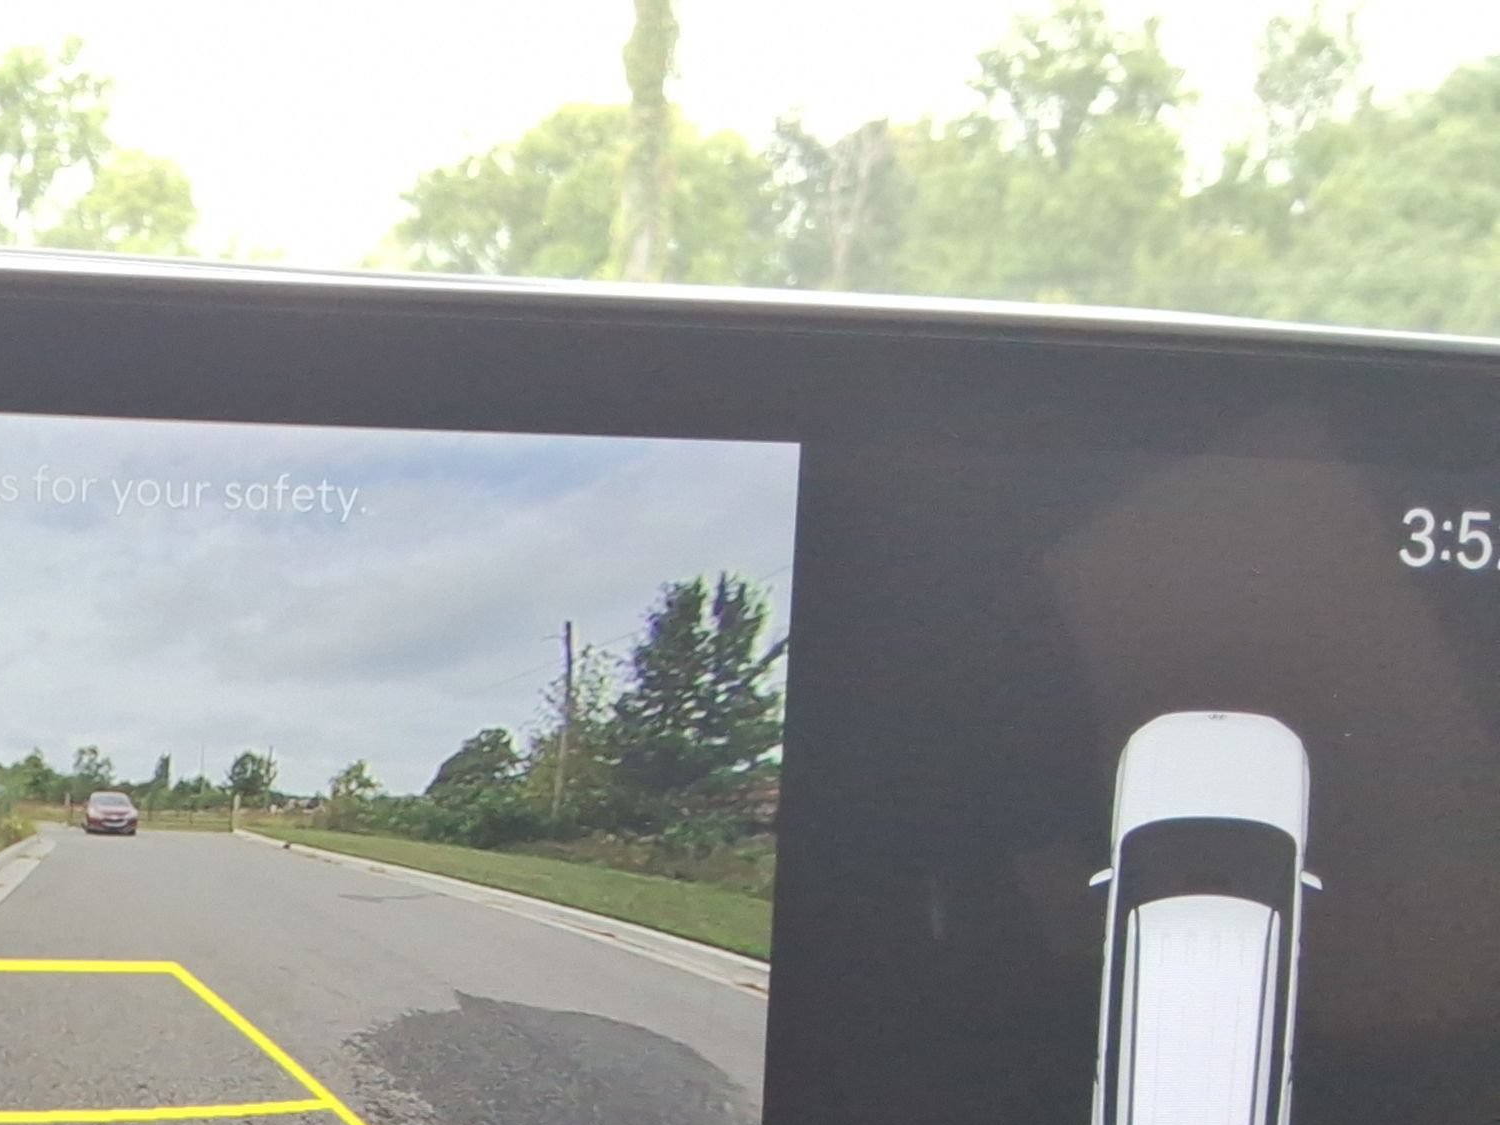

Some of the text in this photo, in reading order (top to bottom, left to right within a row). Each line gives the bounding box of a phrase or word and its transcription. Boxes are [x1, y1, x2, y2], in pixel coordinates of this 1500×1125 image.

[32, 464, 98, 505] for
[111, 476, 211, 516] your
[223, 473, 368, 523] safety.
[1399, 507, 1500, 570] 3:5
